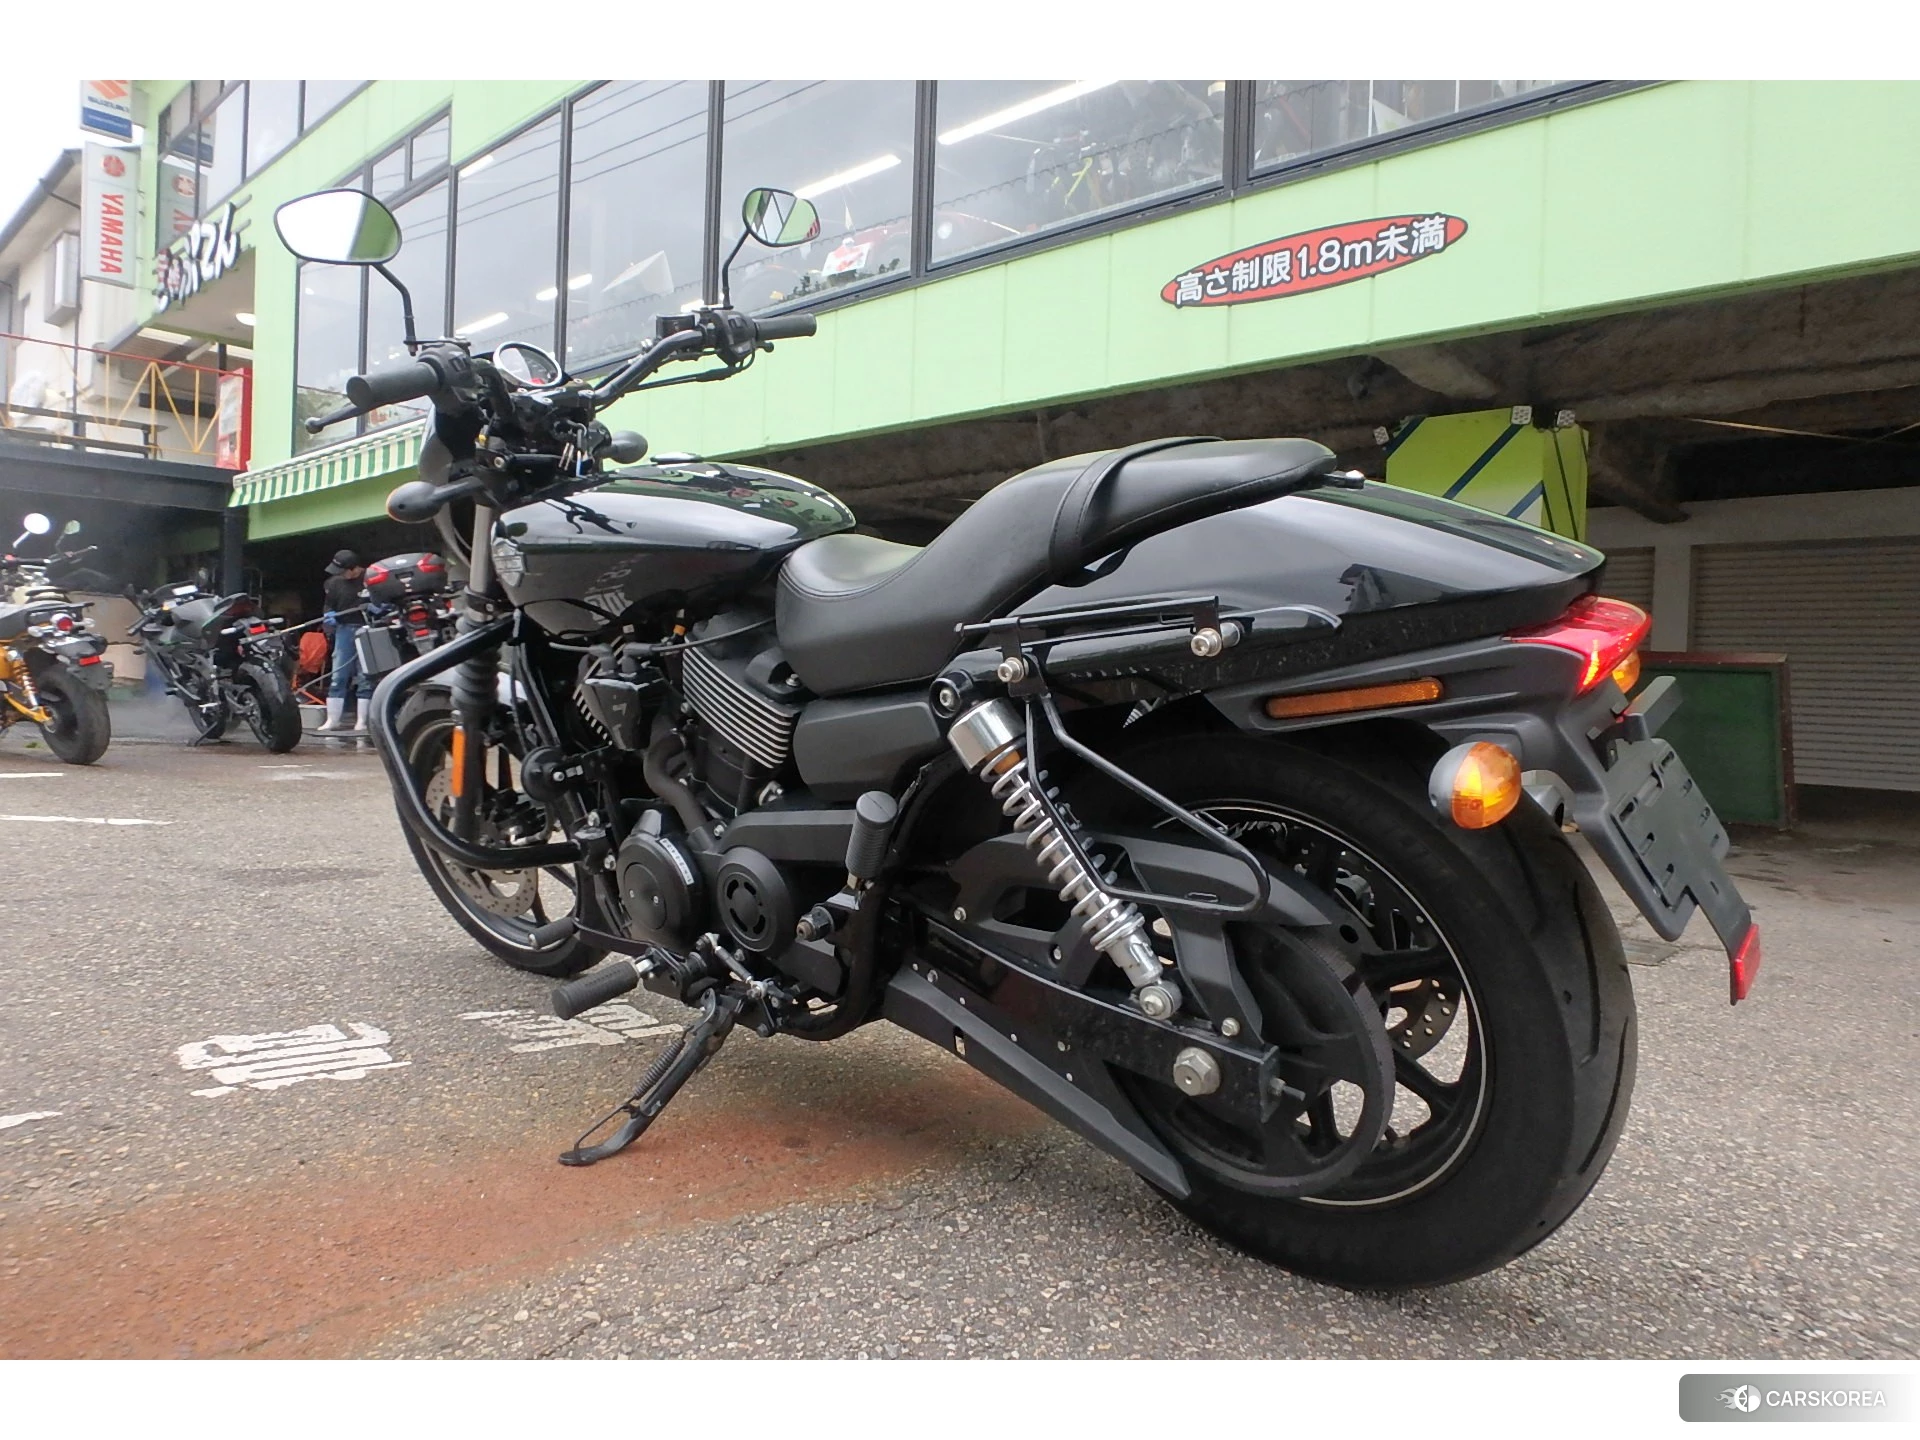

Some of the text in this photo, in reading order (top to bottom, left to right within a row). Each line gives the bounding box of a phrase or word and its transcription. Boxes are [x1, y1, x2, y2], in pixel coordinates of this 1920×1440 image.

[100, 193, 124, 274] YAMAHA
[1174, 214, 1447, 306] 高さ制限1.8m未満
